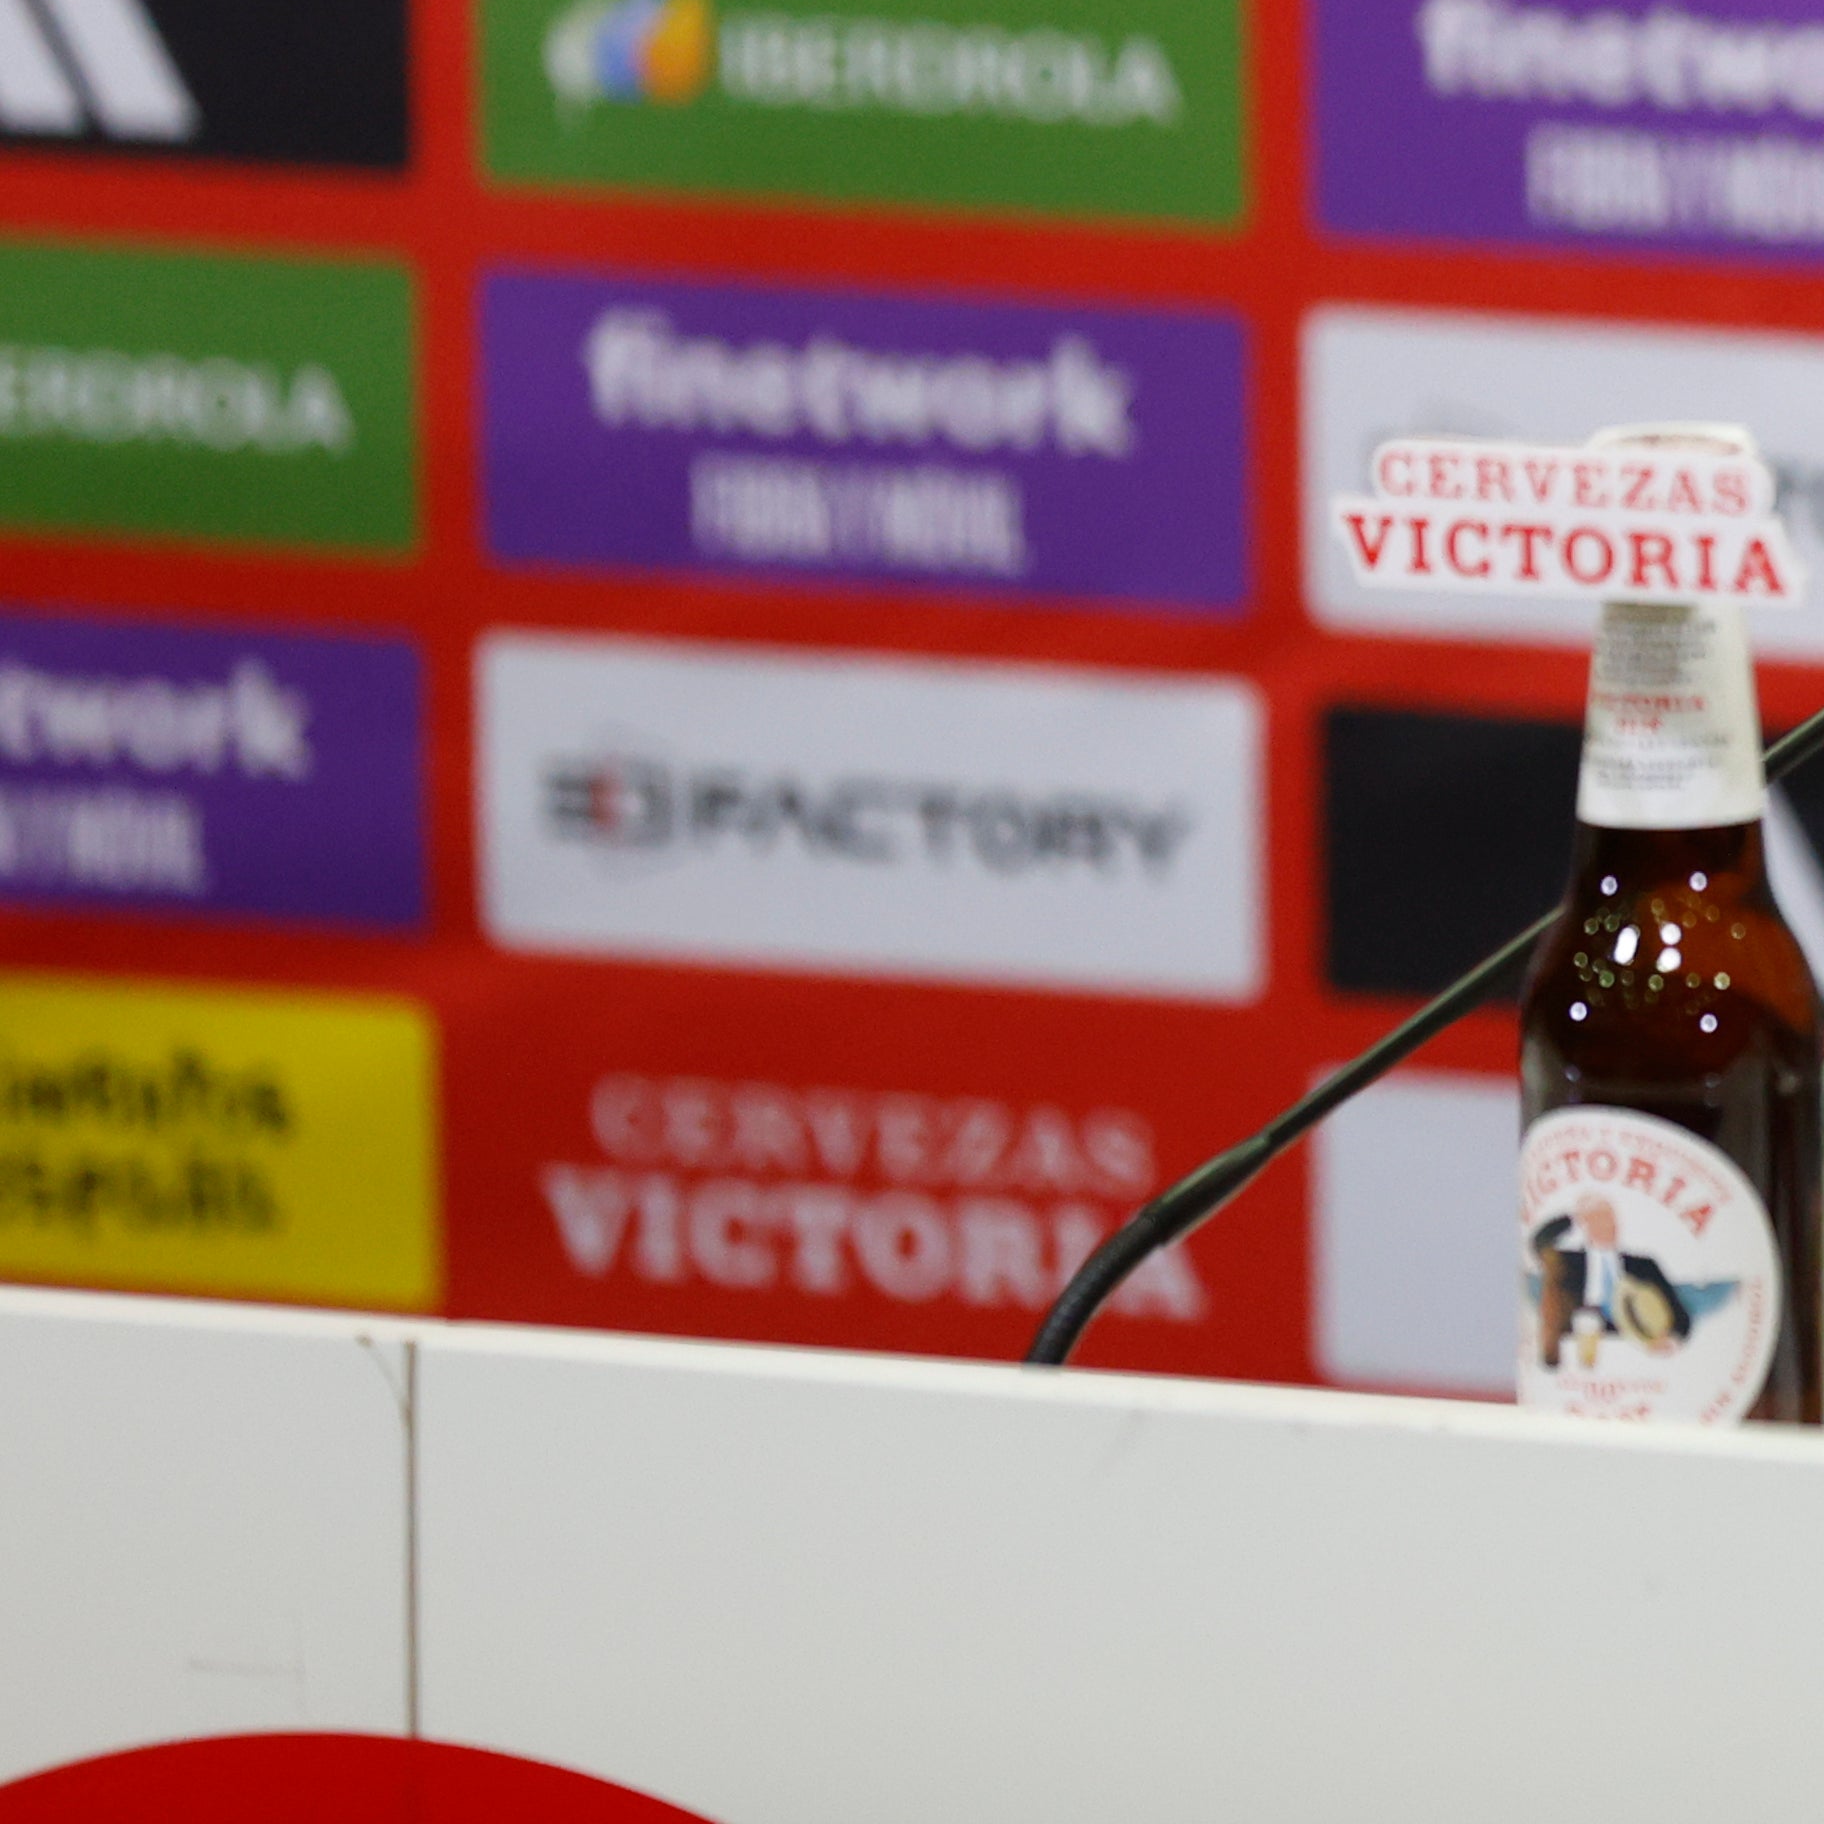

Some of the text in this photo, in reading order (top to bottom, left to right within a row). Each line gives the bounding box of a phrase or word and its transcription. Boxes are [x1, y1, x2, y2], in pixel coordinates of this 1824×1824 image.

[585, 311, 1132, 455] finetwork
[1378, 449, 1751, 518] CERVEZAS
[1344, 512, 1787, 595] VICTORIA
[688, 766, 1188, 876] FACTORY
[590, 1081, 1156, 1197] CERVEZAS
